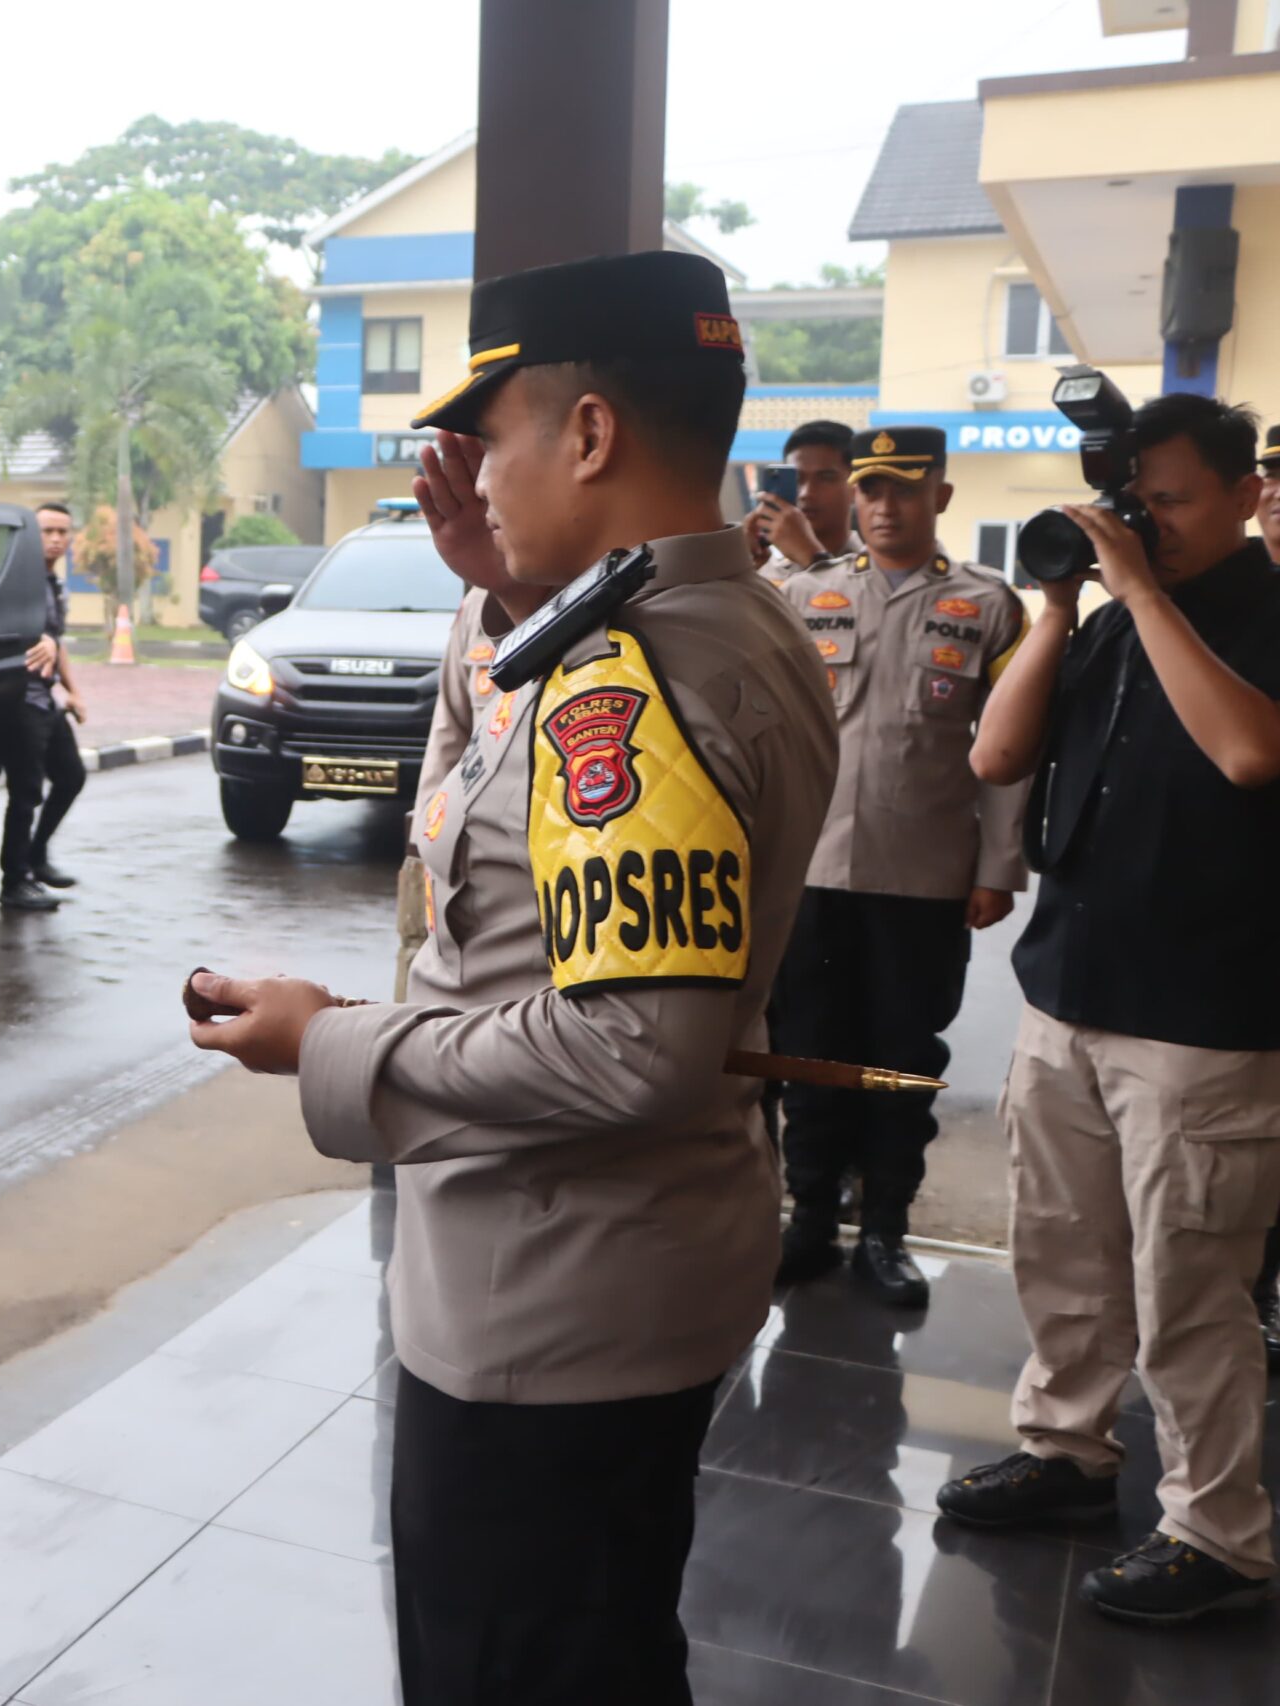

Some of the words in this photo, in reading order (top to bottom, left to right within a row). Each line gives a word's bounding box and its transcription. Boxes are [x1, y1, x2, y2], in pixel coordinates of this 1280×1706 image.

[959, 425, 1083, 449] PROVO
[924, 619, 983, 644] POLRI
[330, 658, 395, 676] ISUZU
[559, 698, 624, 724] POLRES
[568, 706, 612, 725] LEBAK
[566, 725, 618, 747] BANTEN
